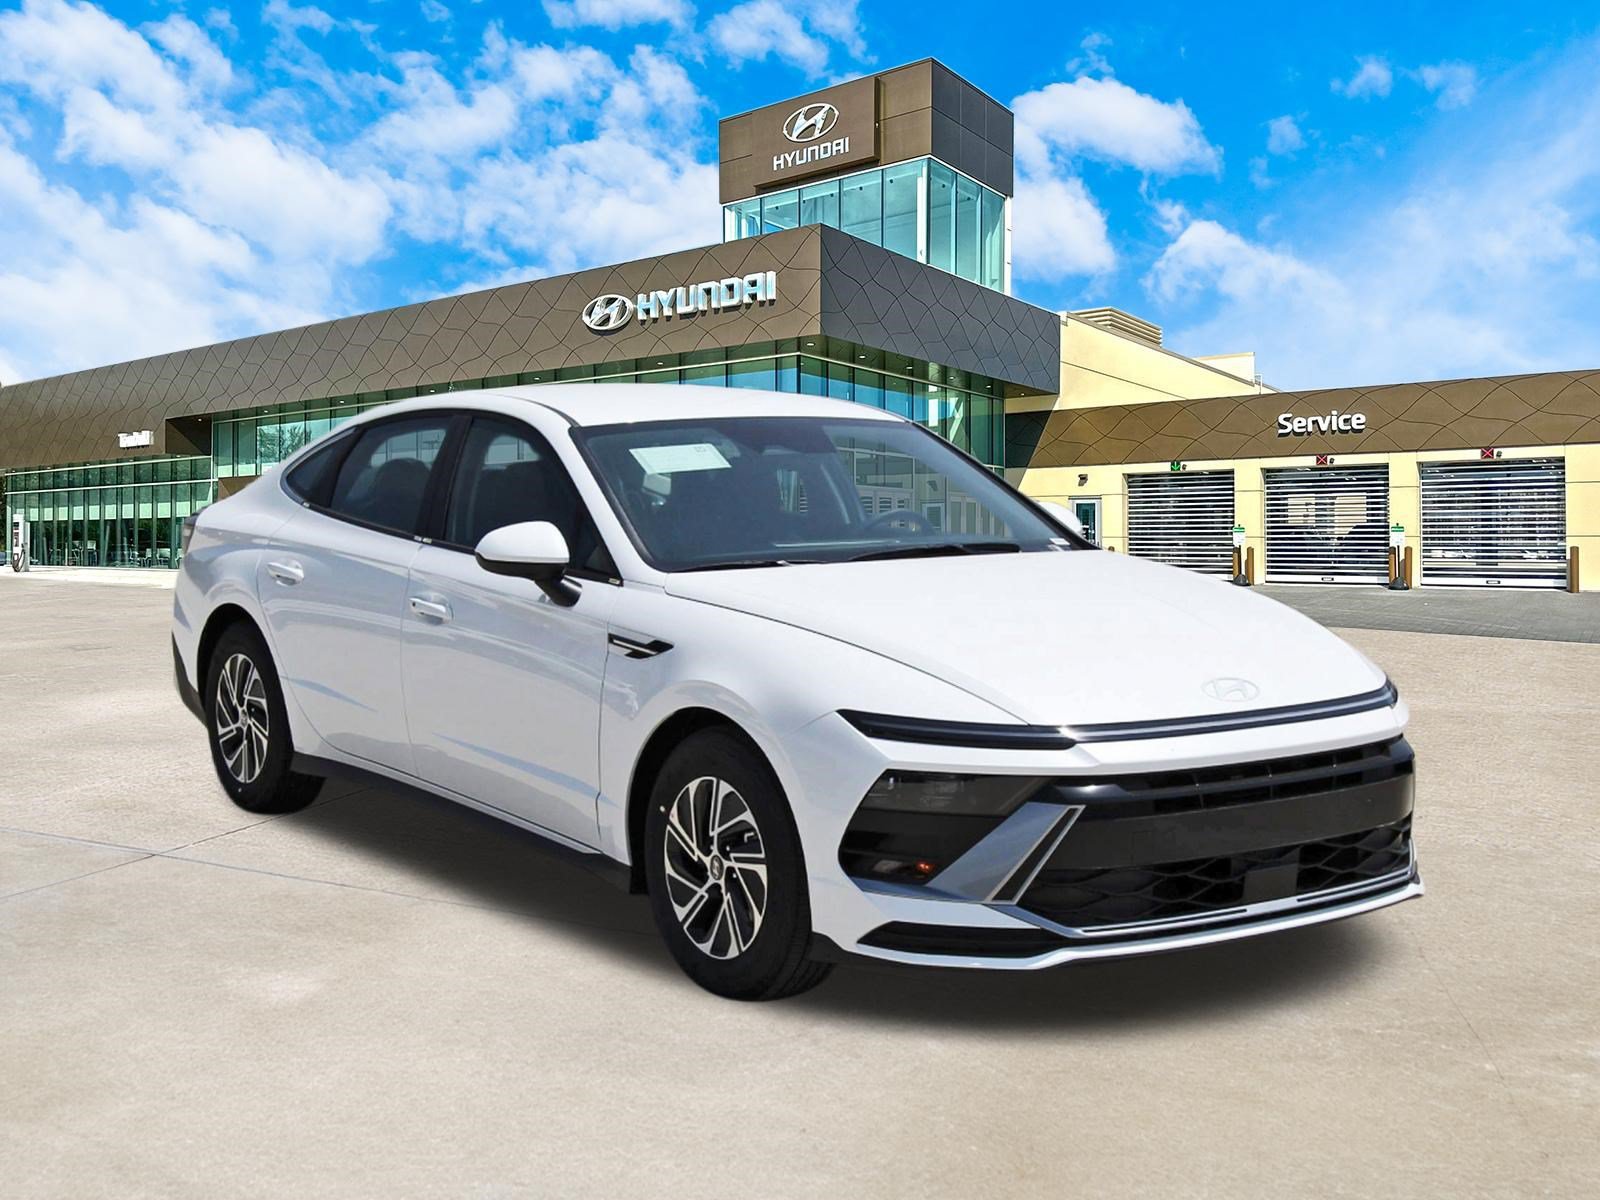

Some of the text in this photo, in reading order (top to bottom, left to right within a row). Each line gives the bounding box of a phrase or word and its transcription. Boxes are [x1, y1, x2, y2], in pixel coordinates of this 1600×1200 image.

[773, 137, 849, 171] HYUNDAI
[636, 271, 776, 321] HYUNDAI
[1277, 410, 1367, 434] Service
